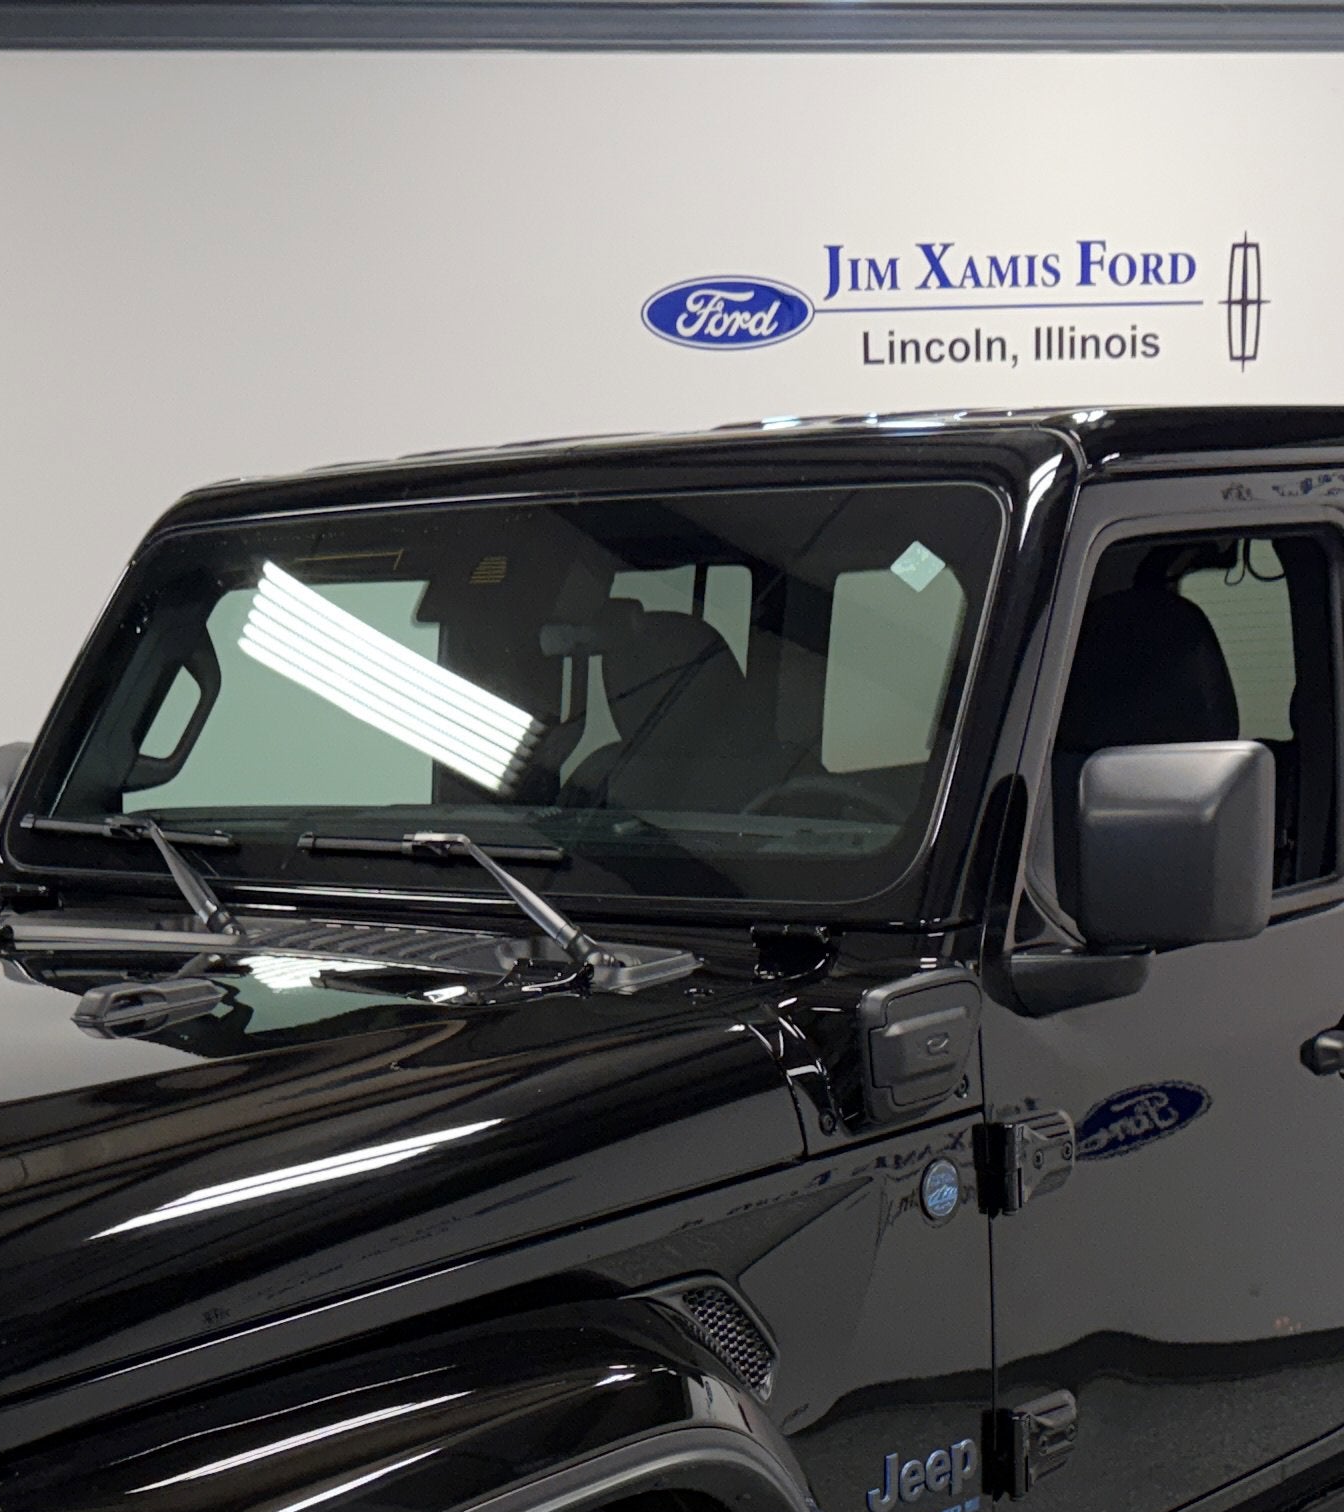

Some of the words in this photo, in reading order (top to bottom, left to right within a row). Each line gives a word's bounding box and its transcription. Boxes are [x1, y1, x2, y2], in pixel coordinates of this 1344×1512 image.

[914, 242, 1061, 290] XAMIS
[1076, 240, 1197, 287] FORD
[675, 289, 781, 338] Ford
[862, 327, 1018, 368] Lincoln,
[1034, 324, 1161, 361] Illinois
